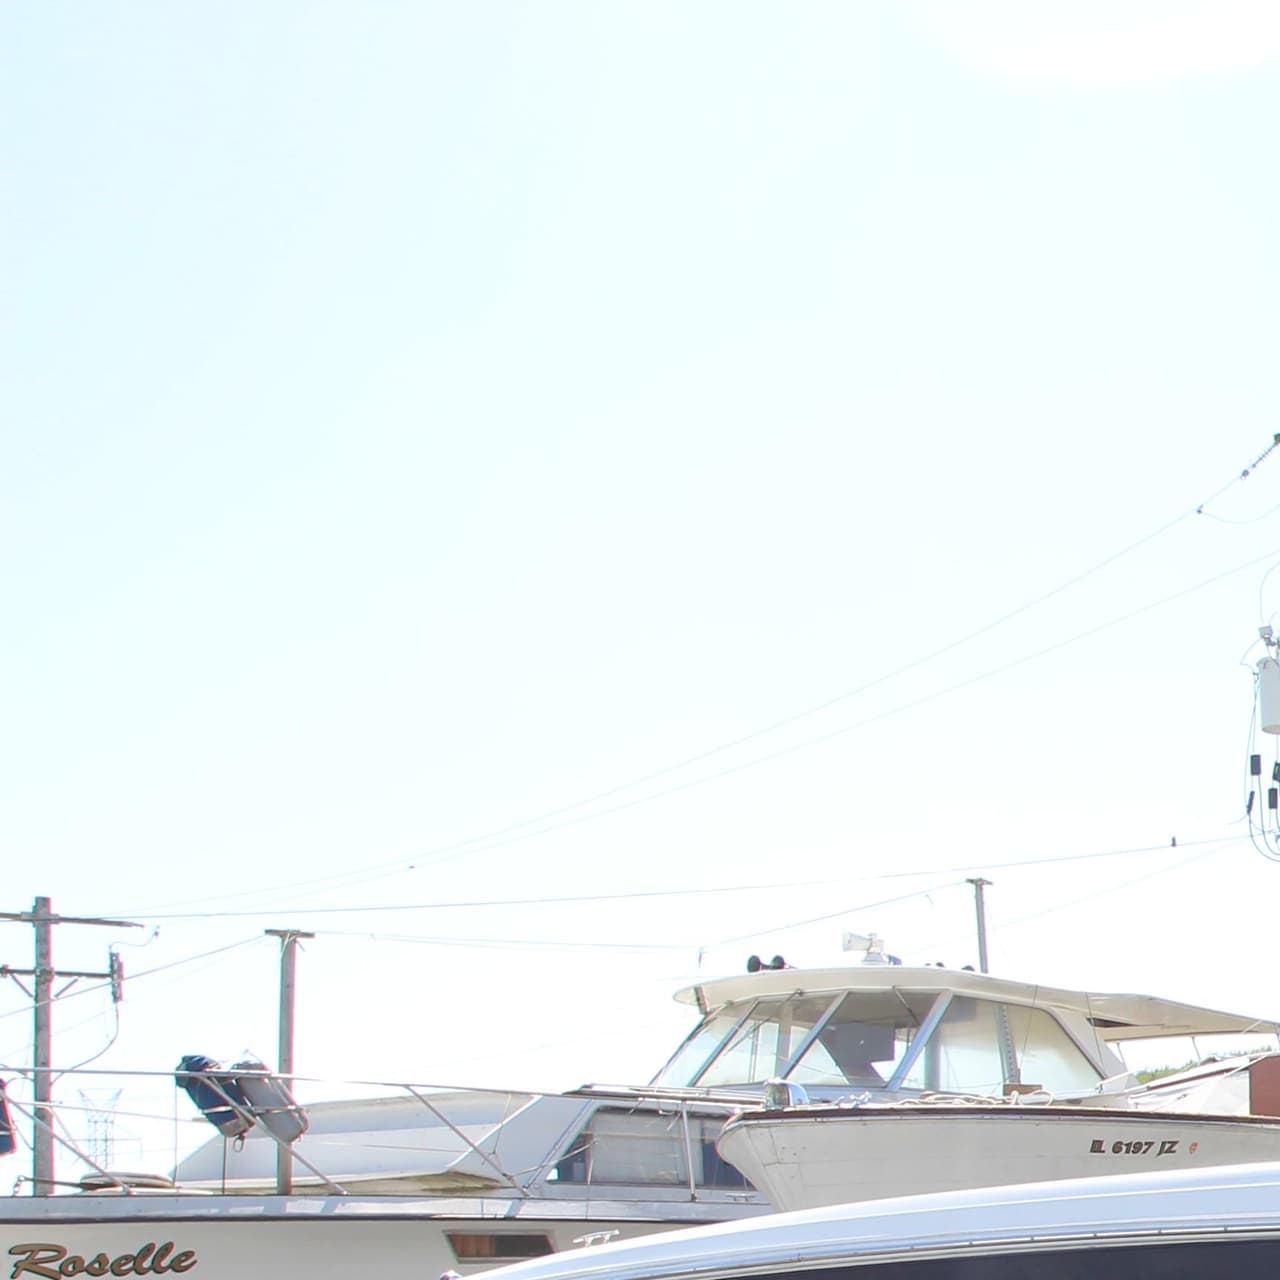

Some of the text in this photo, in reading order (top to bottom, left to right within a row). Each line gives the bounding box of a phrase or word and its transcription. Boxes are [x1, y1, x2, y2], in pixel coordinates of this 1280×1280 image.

[1112, 1141, 1155, 1154] 6197
[1156, 1141, 1179, 1157] JZ
[8, 1241, 198, 1280] Roselle
